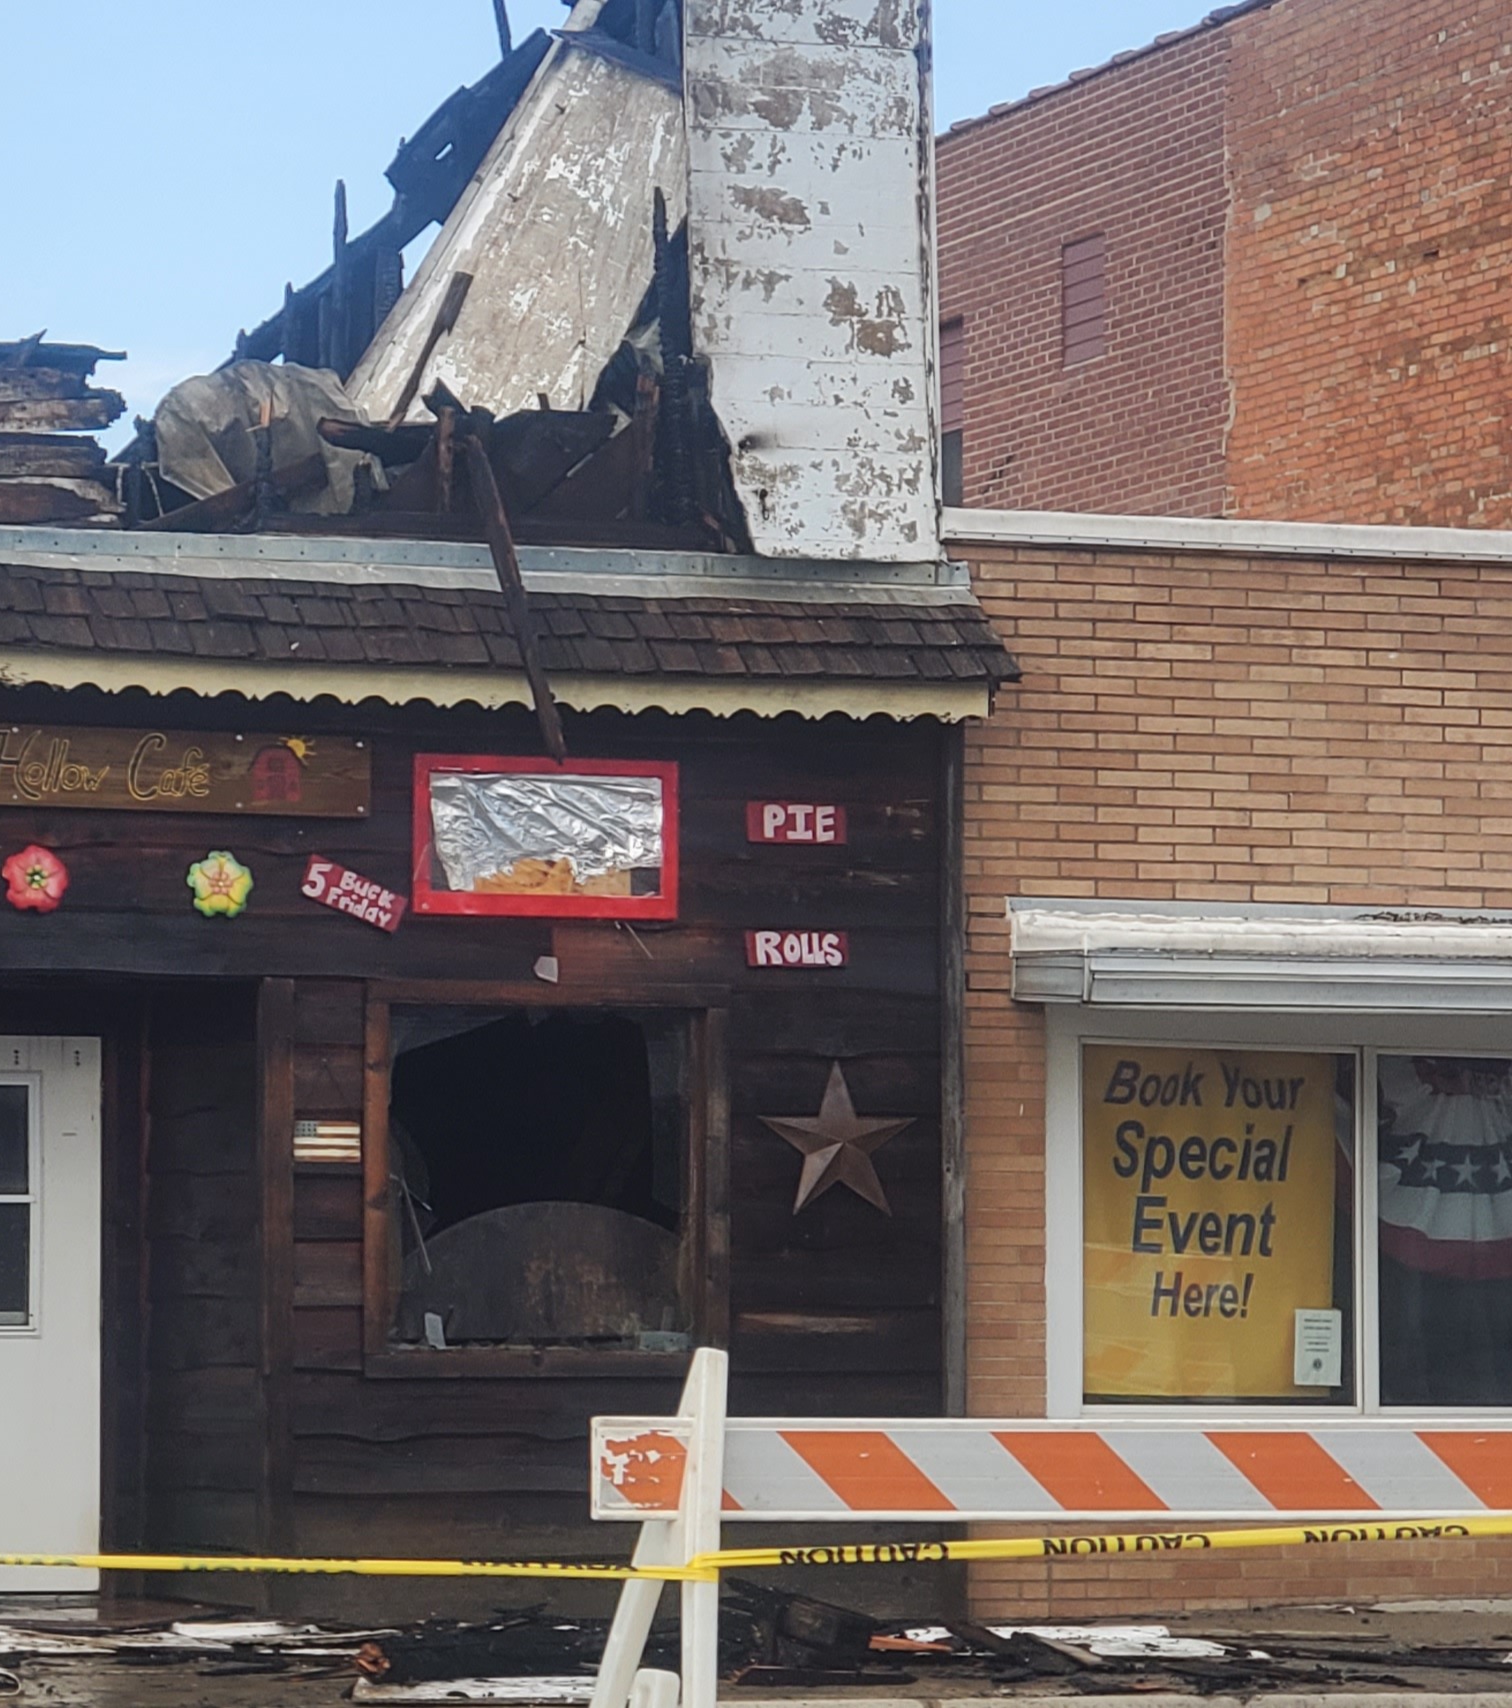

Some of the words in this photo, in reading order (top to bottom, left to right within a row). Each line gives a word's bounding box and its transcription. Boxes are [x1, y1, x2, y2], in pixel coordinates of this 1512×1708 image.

[763, 803, 836, 842] PIE
[301, 863, 333, 898] 5
[754, 931, 843, 966] ROLLS
[1103, 1060, 1204, 1107] Book
[1220, 1062, 1305, 1110] Your
[1112, 1120, 1294, 1193] Special
[1131, 1196, 1276, 1257] Event
[1150, 1271, 1255, 1319] Here!
